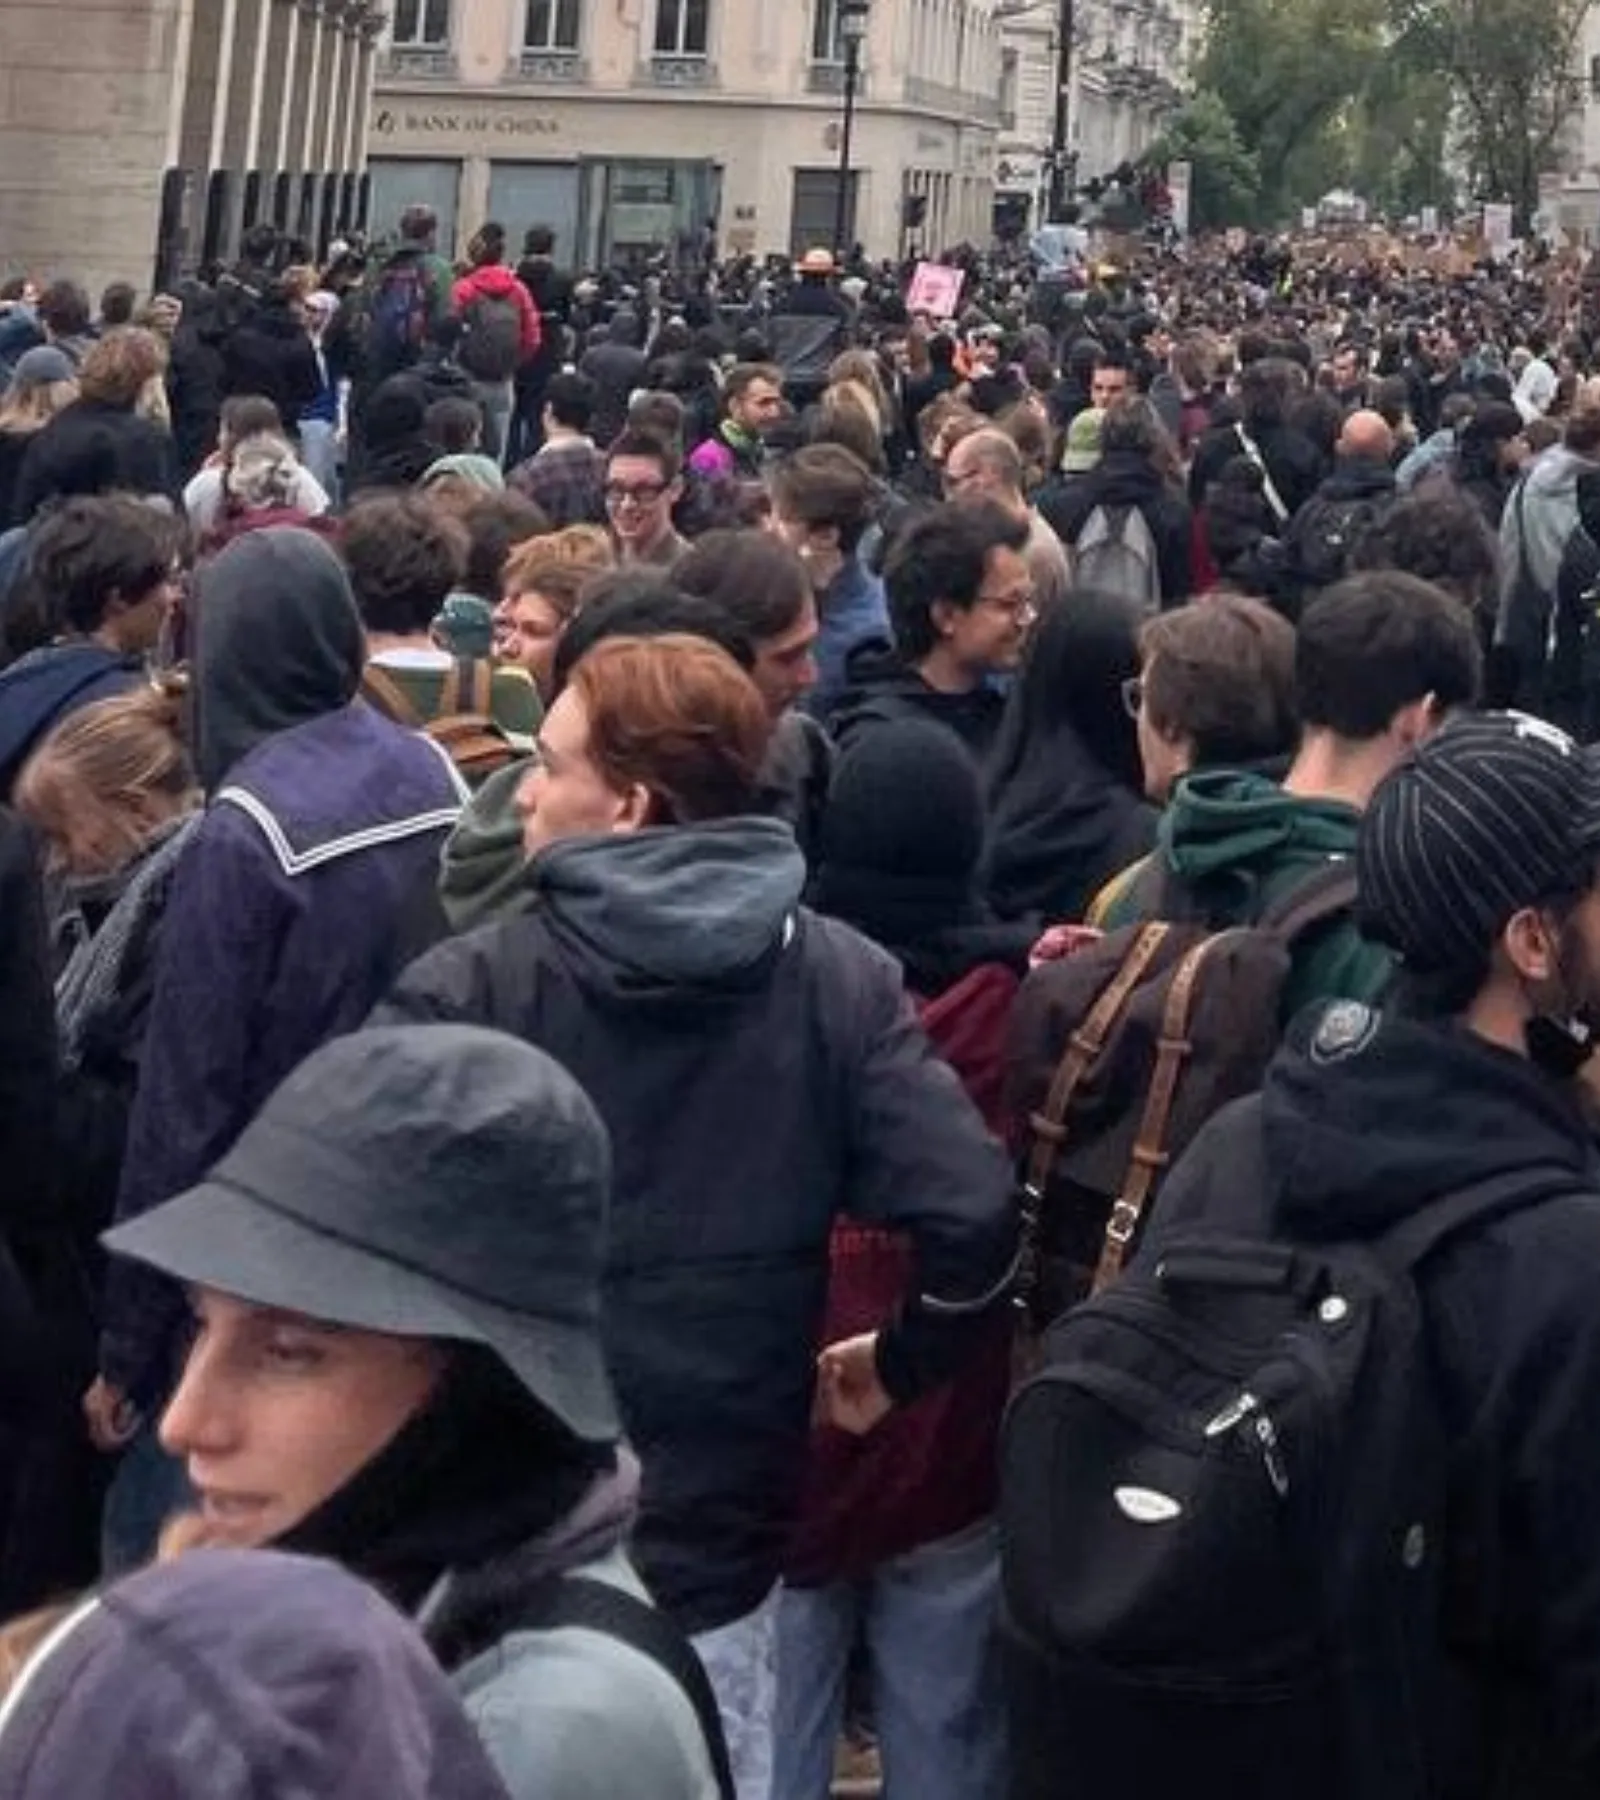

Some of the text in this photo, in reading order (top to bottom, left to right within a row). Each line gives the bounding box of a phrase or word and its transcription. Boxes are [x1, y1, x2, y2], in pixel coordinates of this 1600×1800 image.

[405, 114, 560, 135] BANK OF CHINA
